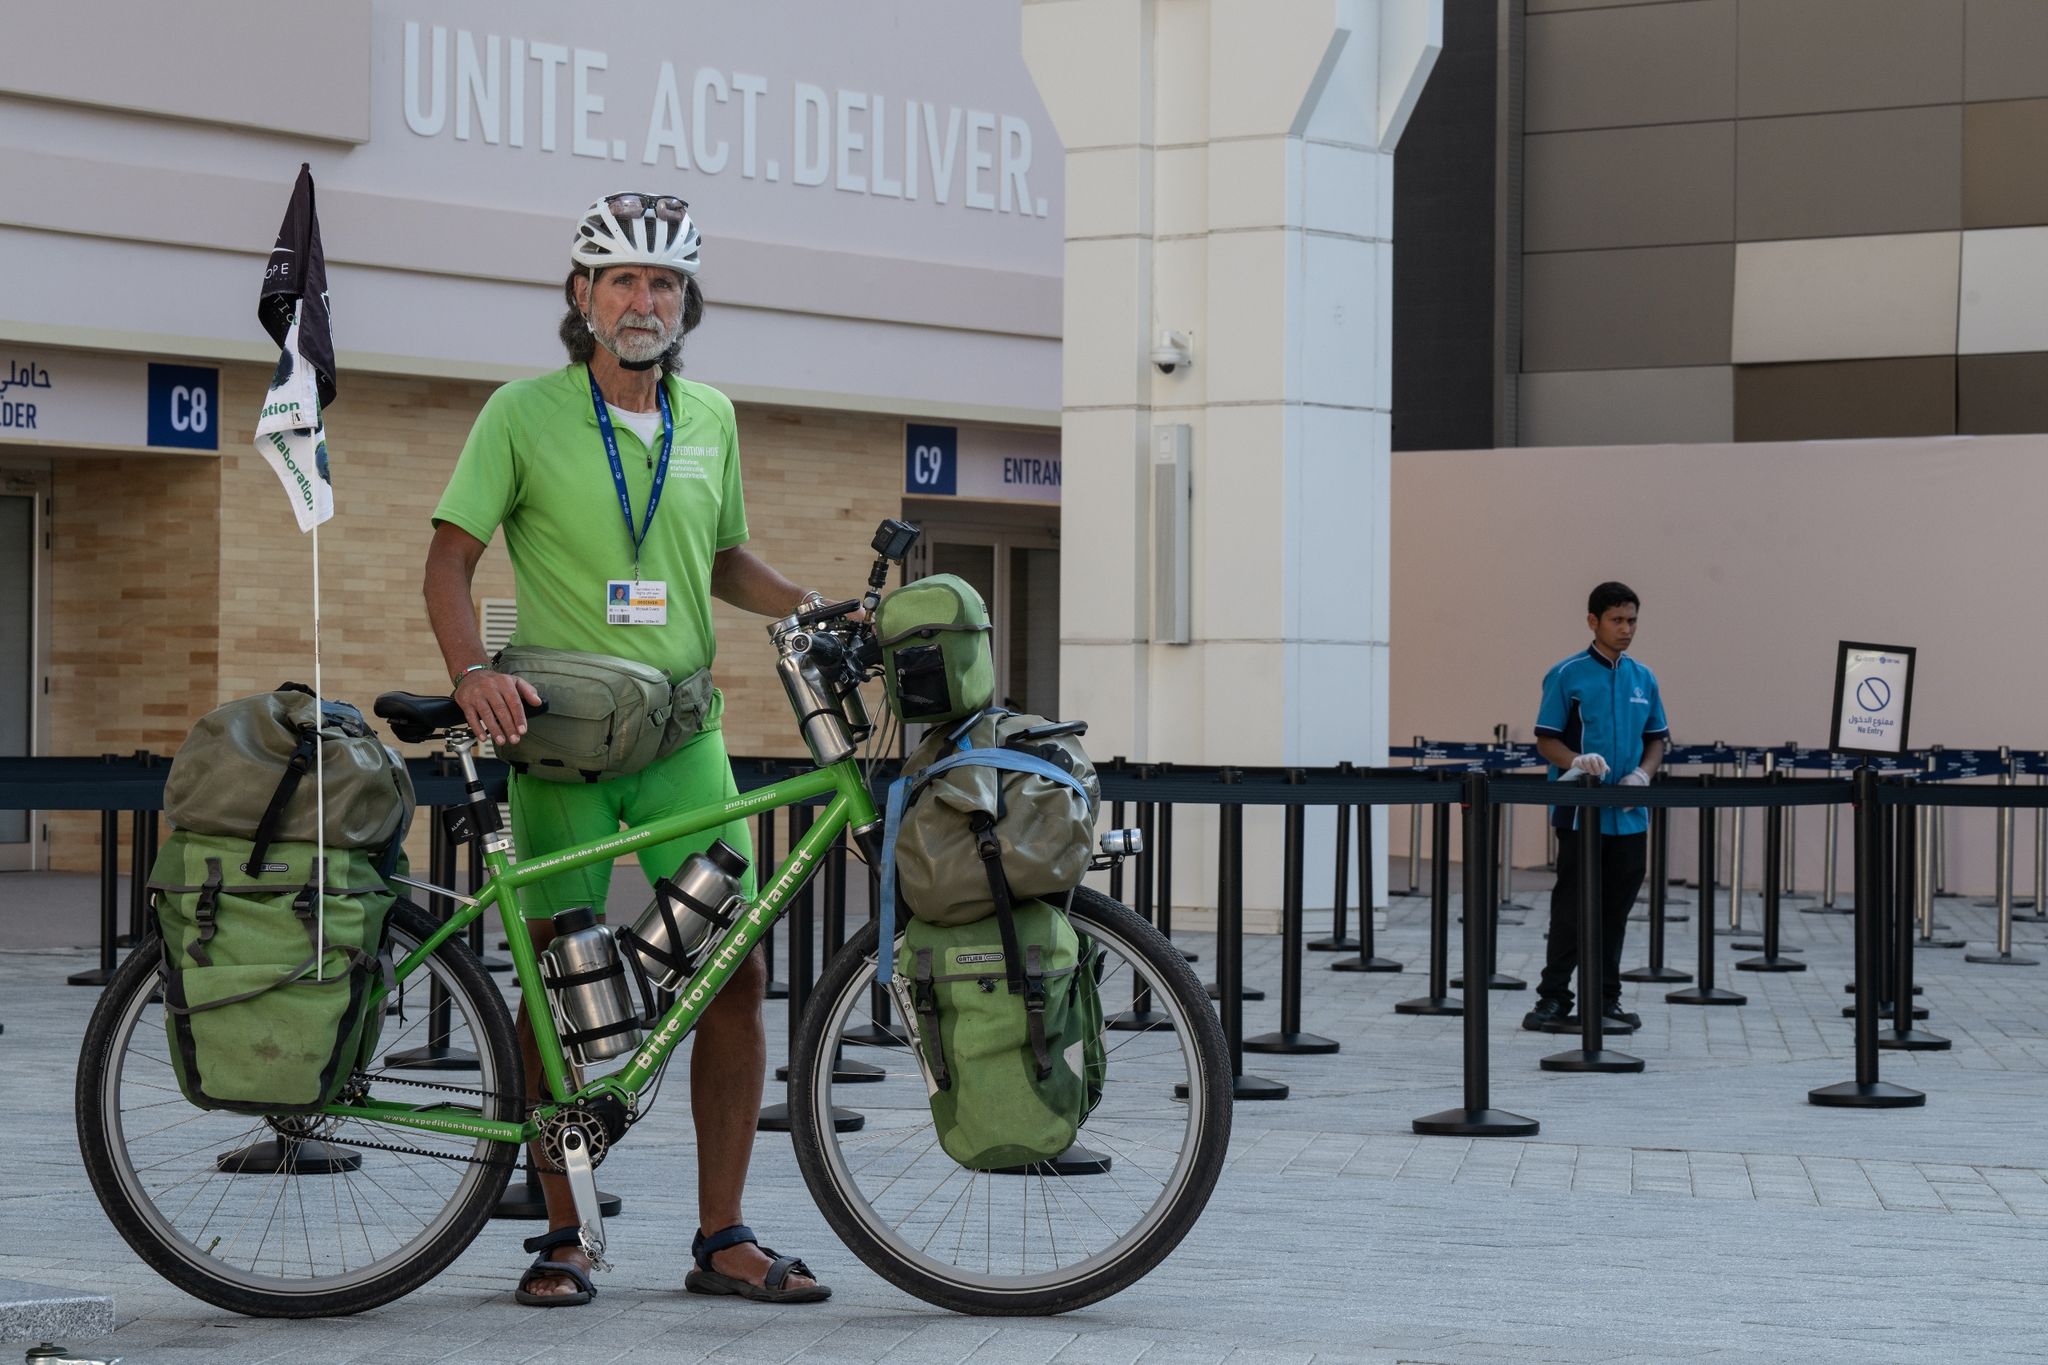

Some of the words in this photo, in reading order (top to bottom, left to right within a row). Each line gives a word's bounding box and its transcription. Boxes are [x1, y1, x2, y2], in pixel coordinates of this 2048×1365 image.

[404, 21, 626, 161] UNITE.
[643, 61, 779, 182] ACT.
[794, 81, 1048, 218] DELIVER.
[0, 402, 37, 429] DER
[171, 385, 207, 433] C8
[266, 431, 314, 511] llaboration
[915, 445, 942, 484] C9
[635, 1017, 680, 1070] Bike
[682, 979, 712, 1011] for
[713, 931, 749, 971] the
[748, 848, 813, 925] Planet
[383, 1113, 513, 1137] www.expedition-hope.earth
